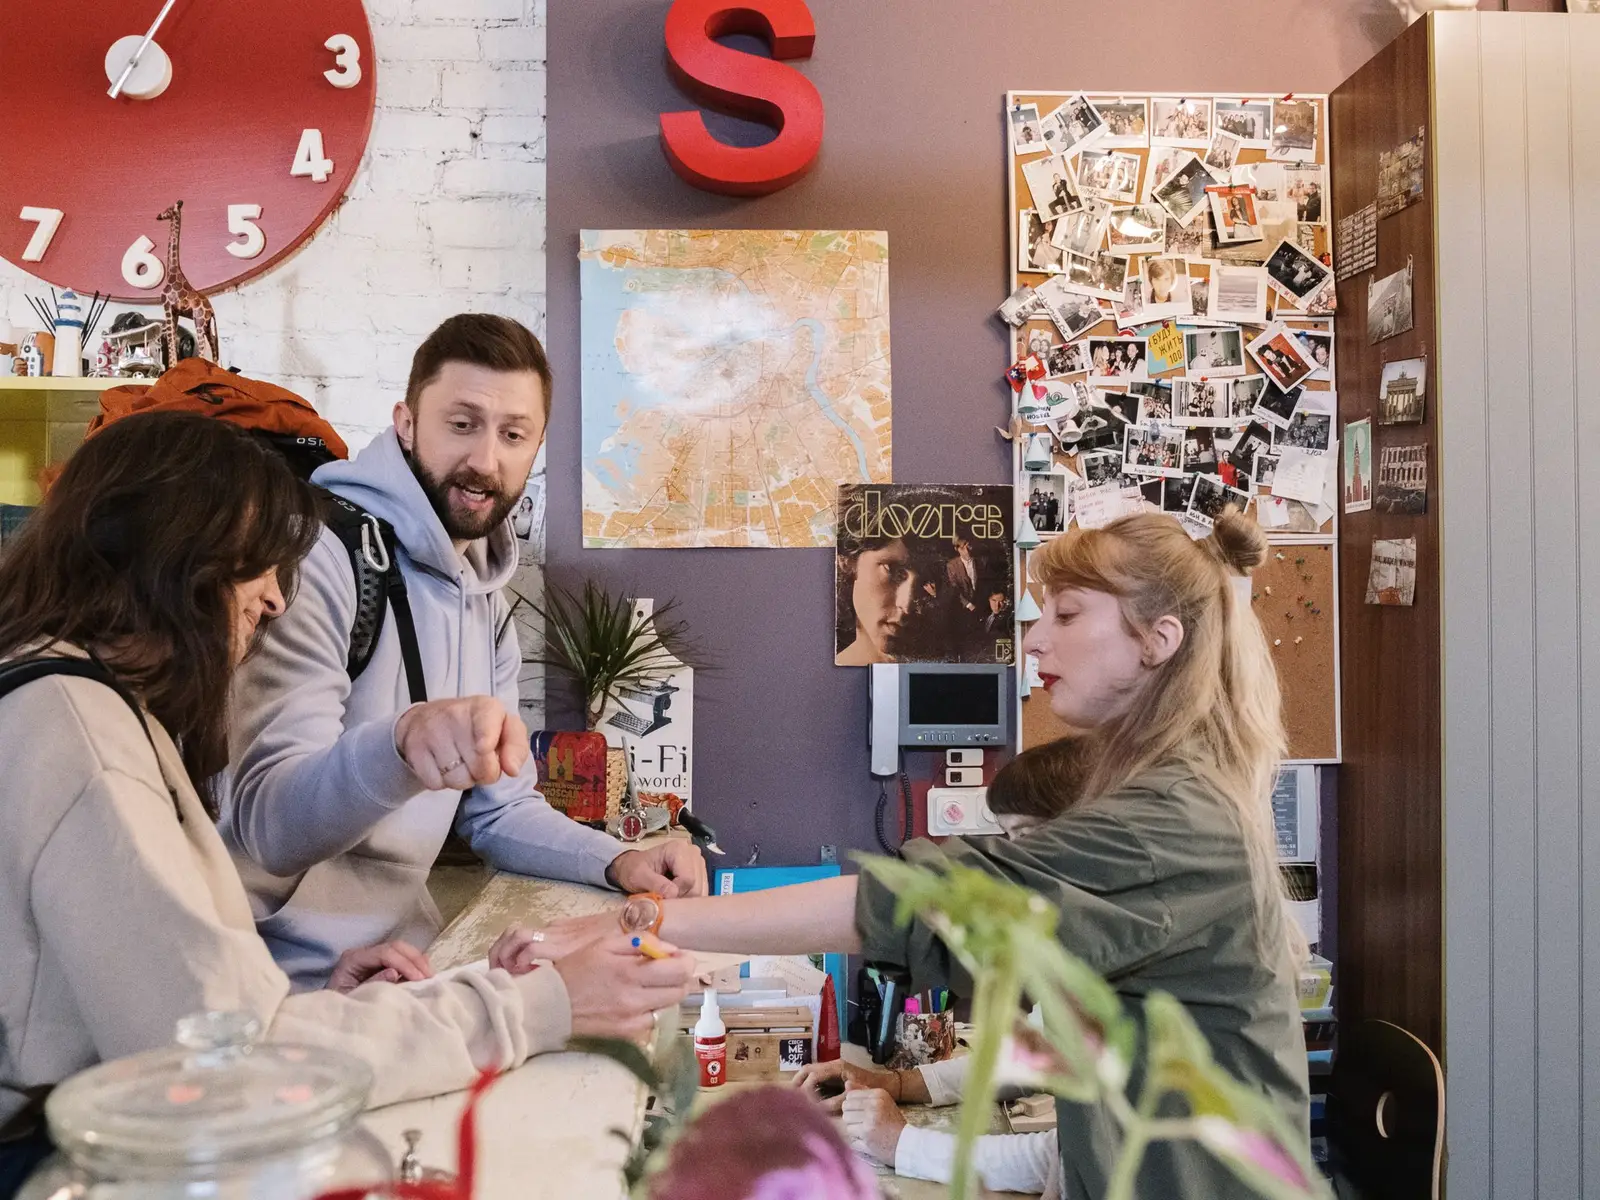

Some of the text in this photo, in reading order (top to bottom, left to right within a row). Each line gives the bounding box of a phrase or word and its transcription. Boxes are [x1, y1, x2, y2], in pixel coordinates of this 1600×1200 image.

[323, 33, 362, 89] 3
[660, 0, 824, 197] S
[290, 128, 334, 183] 4
[19, 206, 64, 262] 7
[225, 204, 266, 259] 5
[121, 235, 165, 289] 6
[1159, 335, 1184, 356] ЖИТЬ
[629, 745, 687, 773] i-Fi
[637, 774, 687, 788] word:
[788, 1044, 804, 1054] ME
[788, 1053, 804, 1061] OUT
